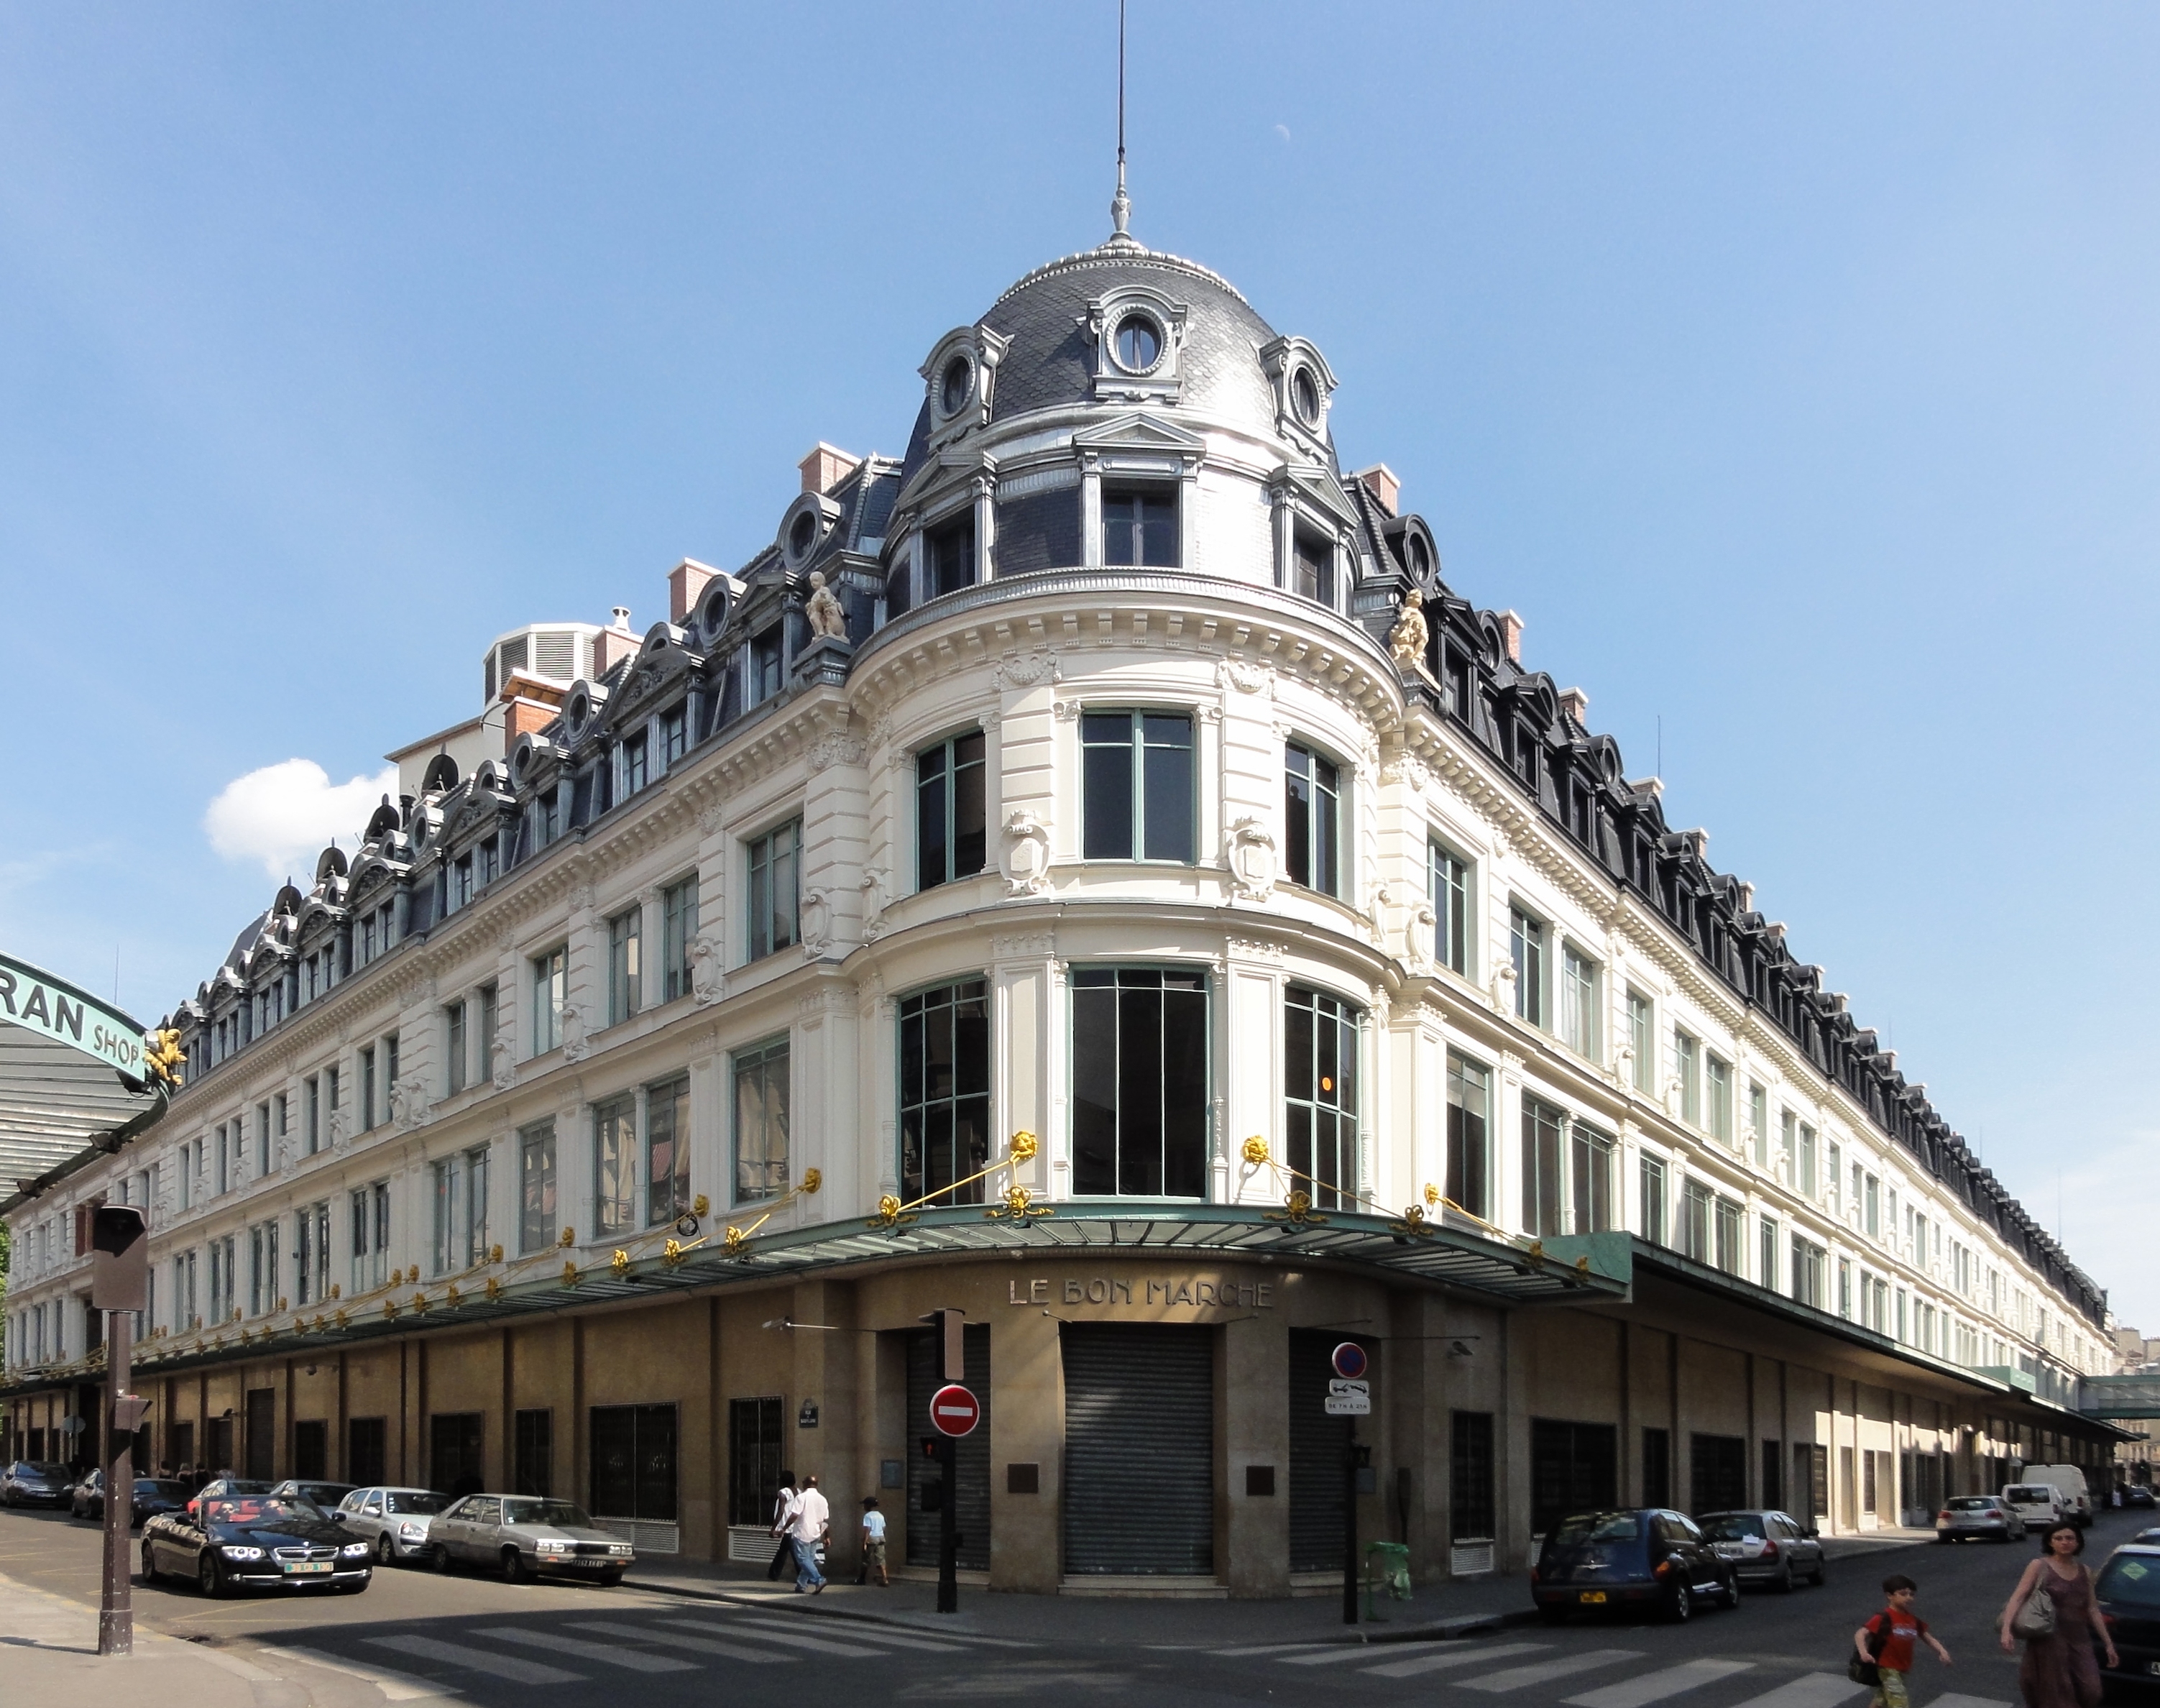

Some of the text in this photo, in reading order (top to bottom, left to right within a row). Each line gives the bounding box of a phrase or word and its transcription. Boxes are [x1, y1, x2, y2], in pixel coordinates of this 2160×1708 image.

[93, 1024, 139, 1067] SHOP
[1010, 1278, 1274, 1308] LE BON MARCHE
